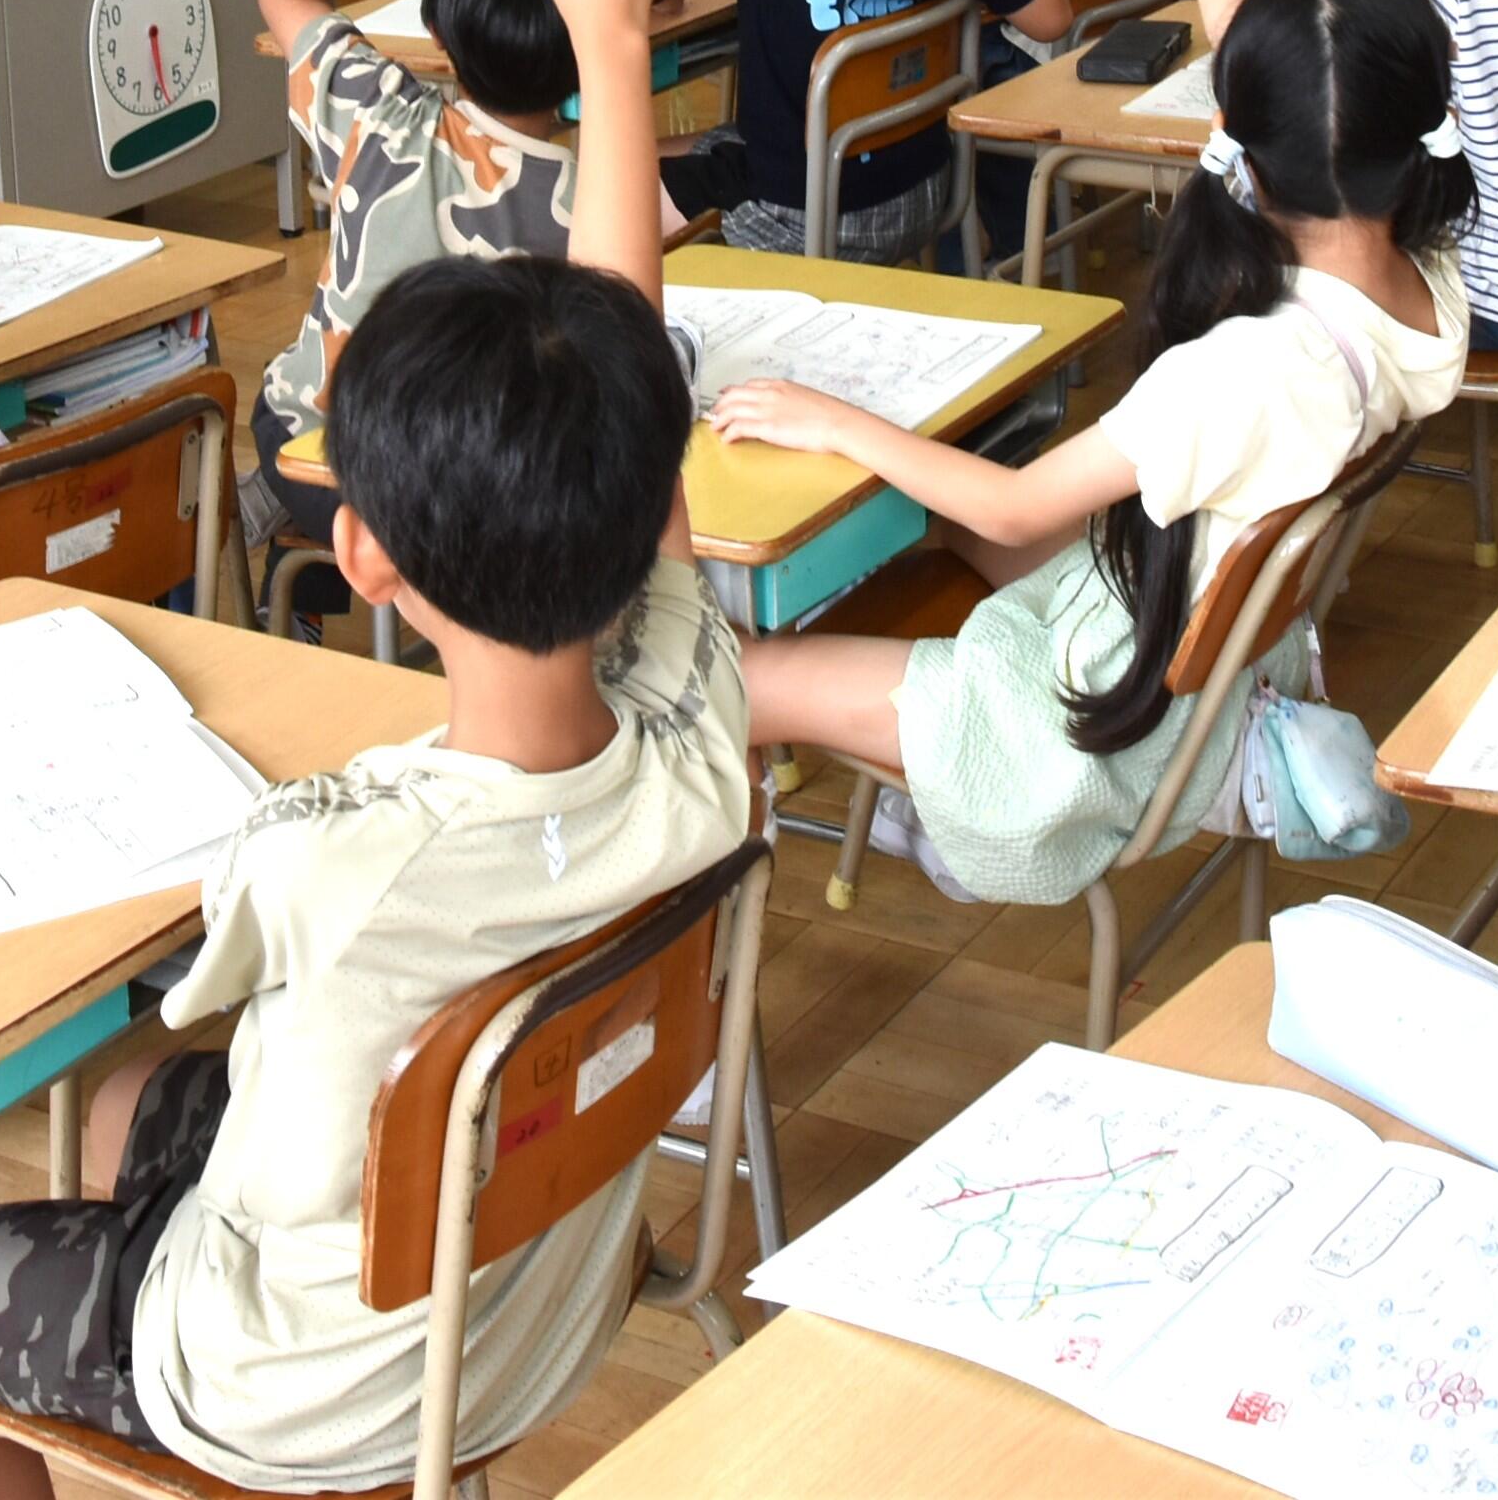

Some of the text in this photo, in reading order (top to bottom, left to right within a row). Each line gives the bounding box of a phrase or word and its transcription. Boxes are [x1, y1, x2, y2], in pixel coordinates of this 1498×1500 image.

[105, 5, 122, 29] 10
[185, 4, 196, 26] 3
[107, 38, 117, 60] 9
[184, 36, 194, 56] 4
[116, 66, 127, 88] 8
[172, 63, 183, 85] 5
[132, 81, 142, 103] 7
[153, 80, 164, 102] 6
